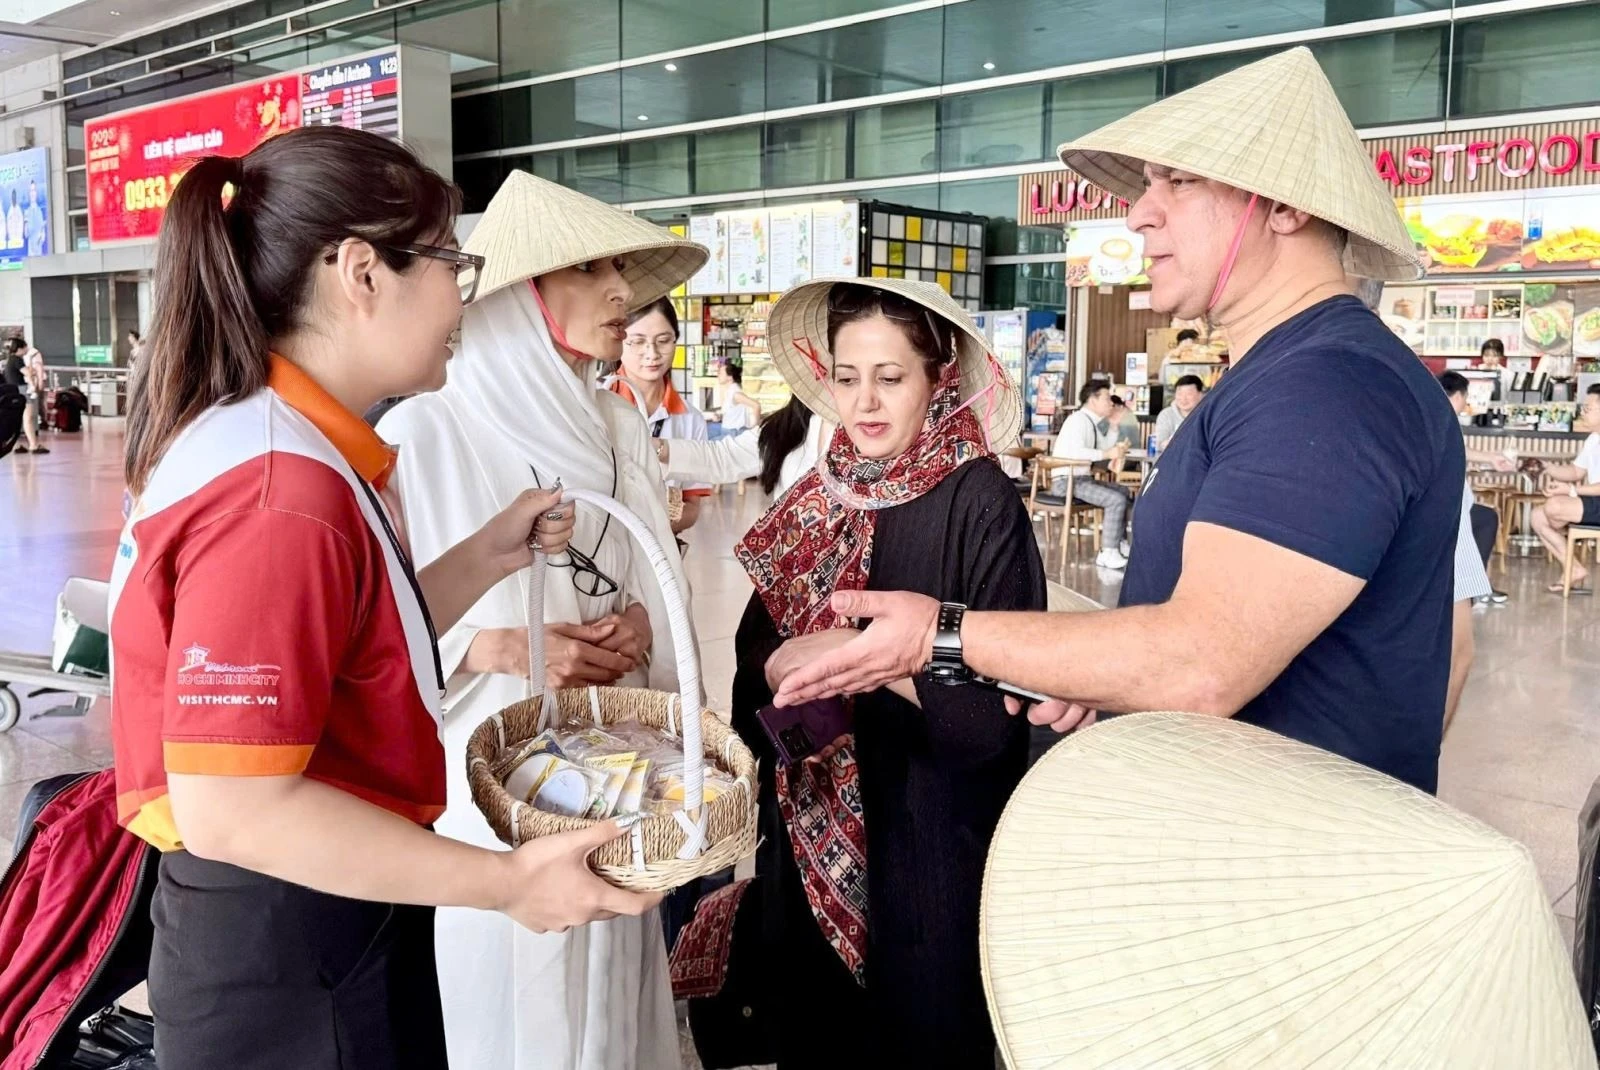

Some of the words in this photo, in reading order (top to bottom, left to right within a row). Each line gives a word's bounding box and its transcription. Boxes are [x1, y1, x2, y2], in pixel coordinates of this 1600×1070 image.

[125, 175, 166, 211] 0933
[215, 673, 248, 686] MINH
[248, 674, 279, 686] CITY
